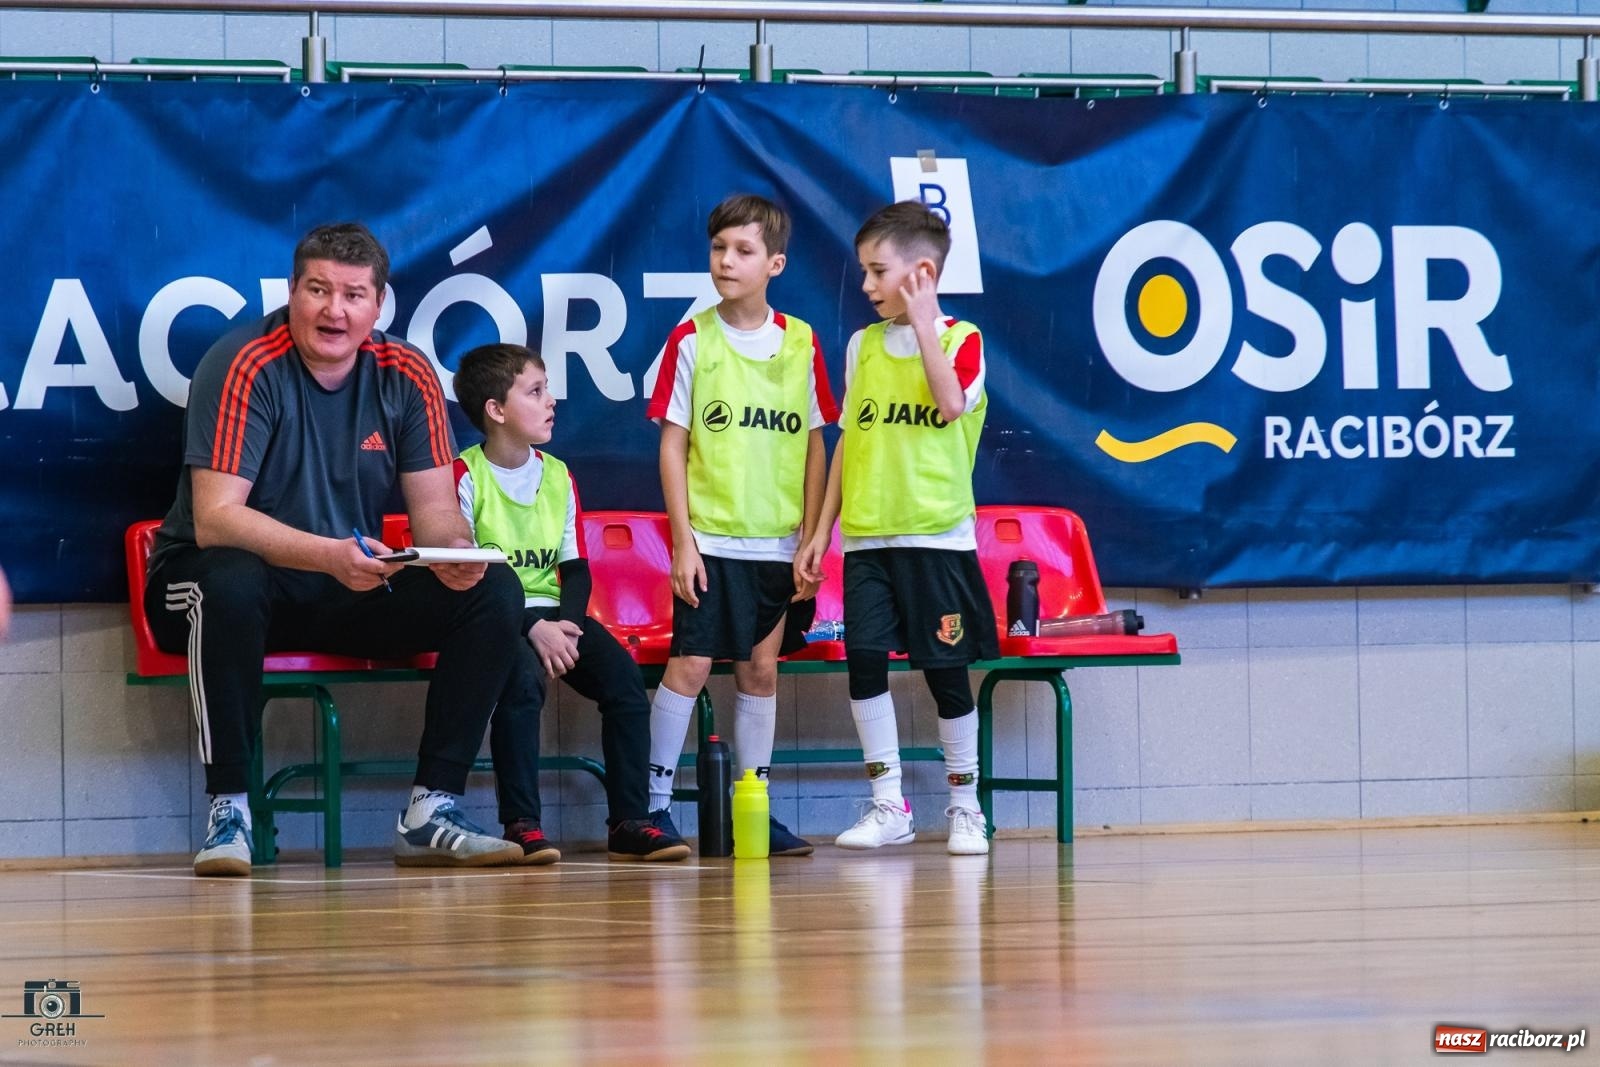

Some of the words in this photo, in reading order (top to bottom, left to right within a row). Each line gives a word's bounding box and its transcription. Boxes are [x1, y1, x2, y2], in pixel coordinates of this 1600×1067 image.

[1093, 220, 1513, 392] OSiR
[739, 406, 802, 434] JAKO
[883, 402, 948, 429] JAKO
[1265, 400, 1516, 459] RACIBÓRZ
[512, 548, 559, 569] JAK
